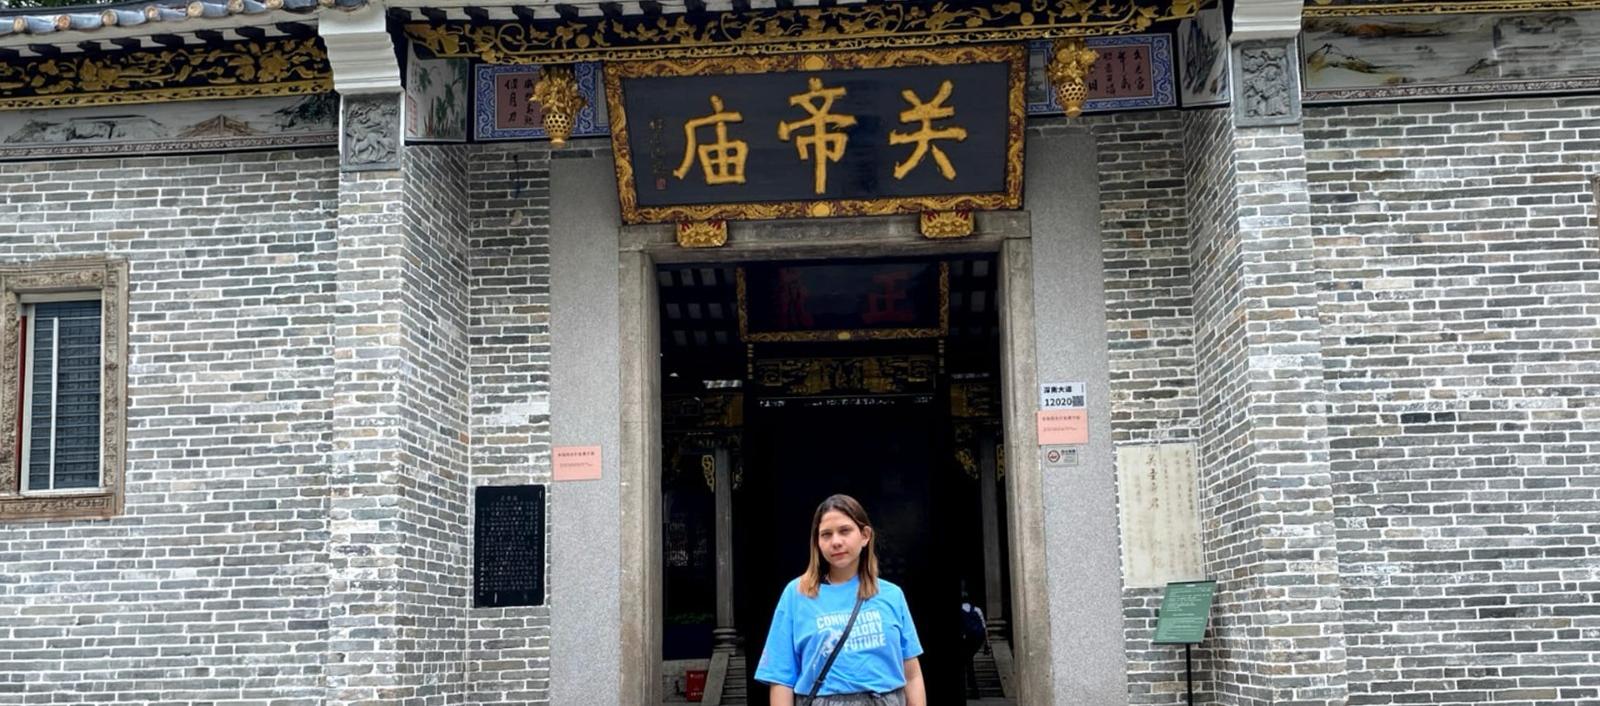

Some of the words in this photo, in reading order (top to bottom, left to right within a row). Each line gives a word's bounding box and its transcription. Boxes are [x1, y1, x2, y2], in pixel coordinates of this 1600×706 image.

[673, 77, 968, 194] 关帝庙
[1045, 397, 1072, 407] 12020
[844, 633, 886, 652] FUTURE
